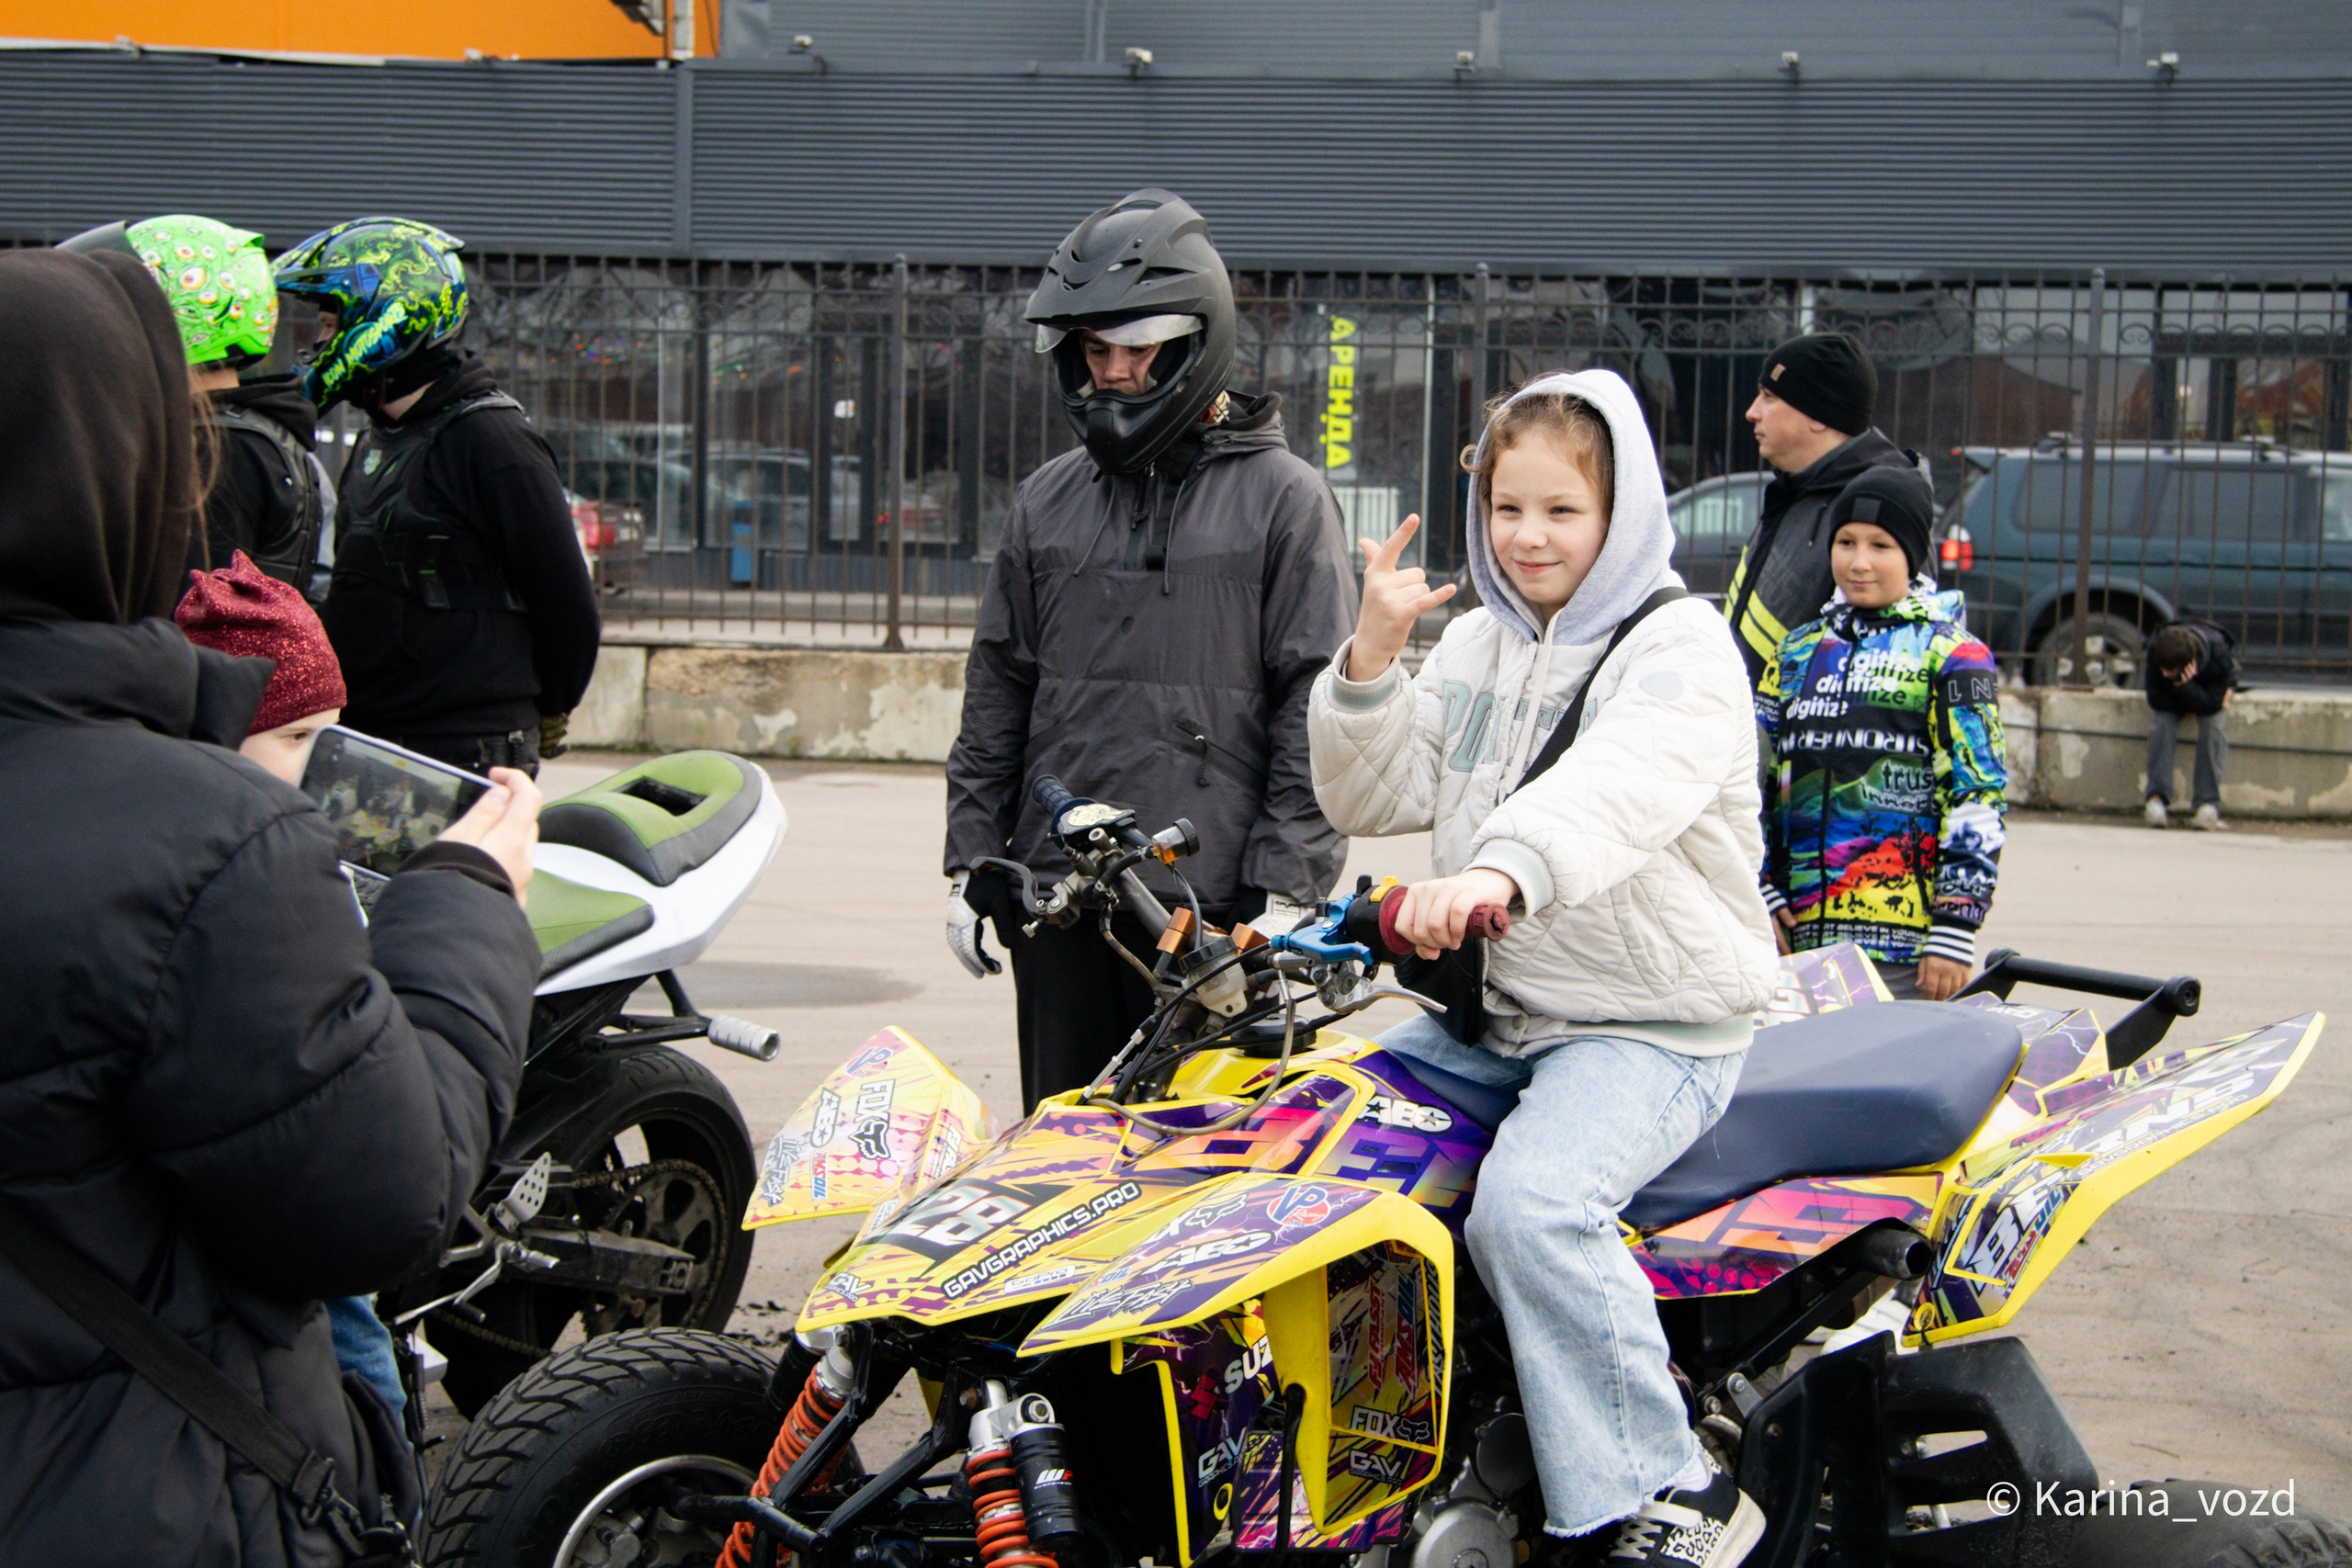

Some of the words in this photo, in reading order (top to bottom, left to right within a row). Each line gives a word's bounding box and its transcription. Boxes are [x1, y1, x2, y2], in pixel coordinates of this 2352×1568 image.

[1319, 314, 1356, 468] АРЕНДА
[1838, 649, 1922, 674] dgitize
[1837, 924, 1878, 933] BELIEVE
[854, 1078, 896, 1124] FOX
[812, 1150, 827, 1201] AMSOIL
[873, 1184, 1033, 1247] 28
[1272, 1185, 1328, 1223] VP
[942, 1181, 1140, 1299] GAVGRAPHICS.PRO
[829, 1272, 873, 1295] GAV
[1012, 1268, 1069, 1286] GoPro
[1091, 1266, 1133, 1287] OIL
[1395, 1272, 1418, 1400] AMSOIL
[1351, 1406, 1400, 1439] FOX
[1198, 1426, 1248, 1480] GAV
[1351, 1450, 1402, 1477] GAV
[1035, 1468, 1073, 1485] WP
